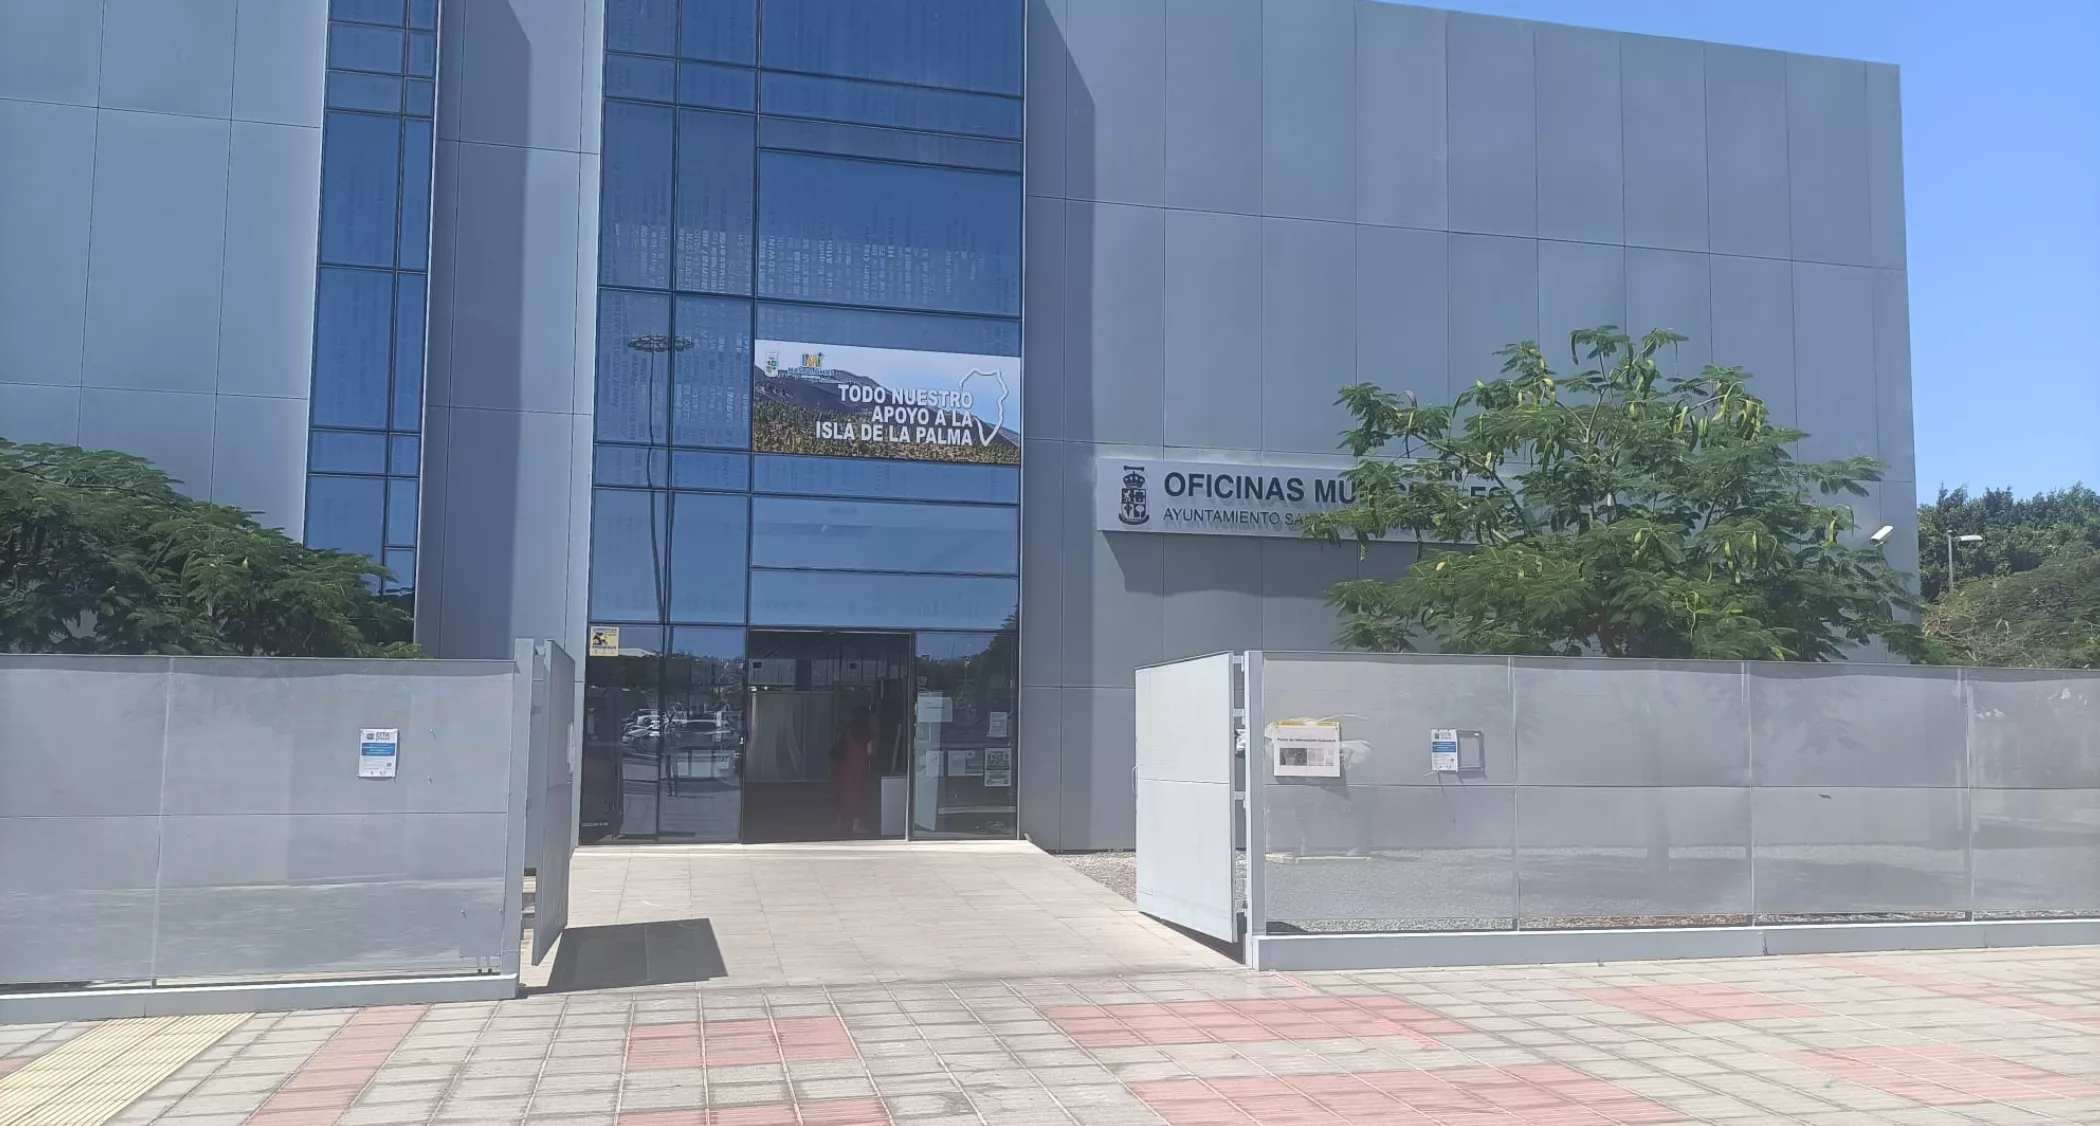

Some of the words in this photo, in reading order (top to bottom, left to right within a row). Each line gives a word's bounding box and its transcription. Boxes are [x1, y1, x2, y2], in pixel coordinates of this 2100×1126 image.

[838, 384, 886, 404] TODO
[892, 388, 973, 408] NUESTRO
[871, 406, 929, 425] APOYO
[935, 409, 947, 426] A
[952, 410, 973, 427] LA
[816, 421, 855, 440] ISLA
[861, 424, 887, 442] DE
[889, 425, 910, 443] LA
[916, 427, 973, 446] PALMA
[1164, 472, 1305, 502] OFICINAS
[1163, 508, 1280, 525] AYUNTAMIENTO
